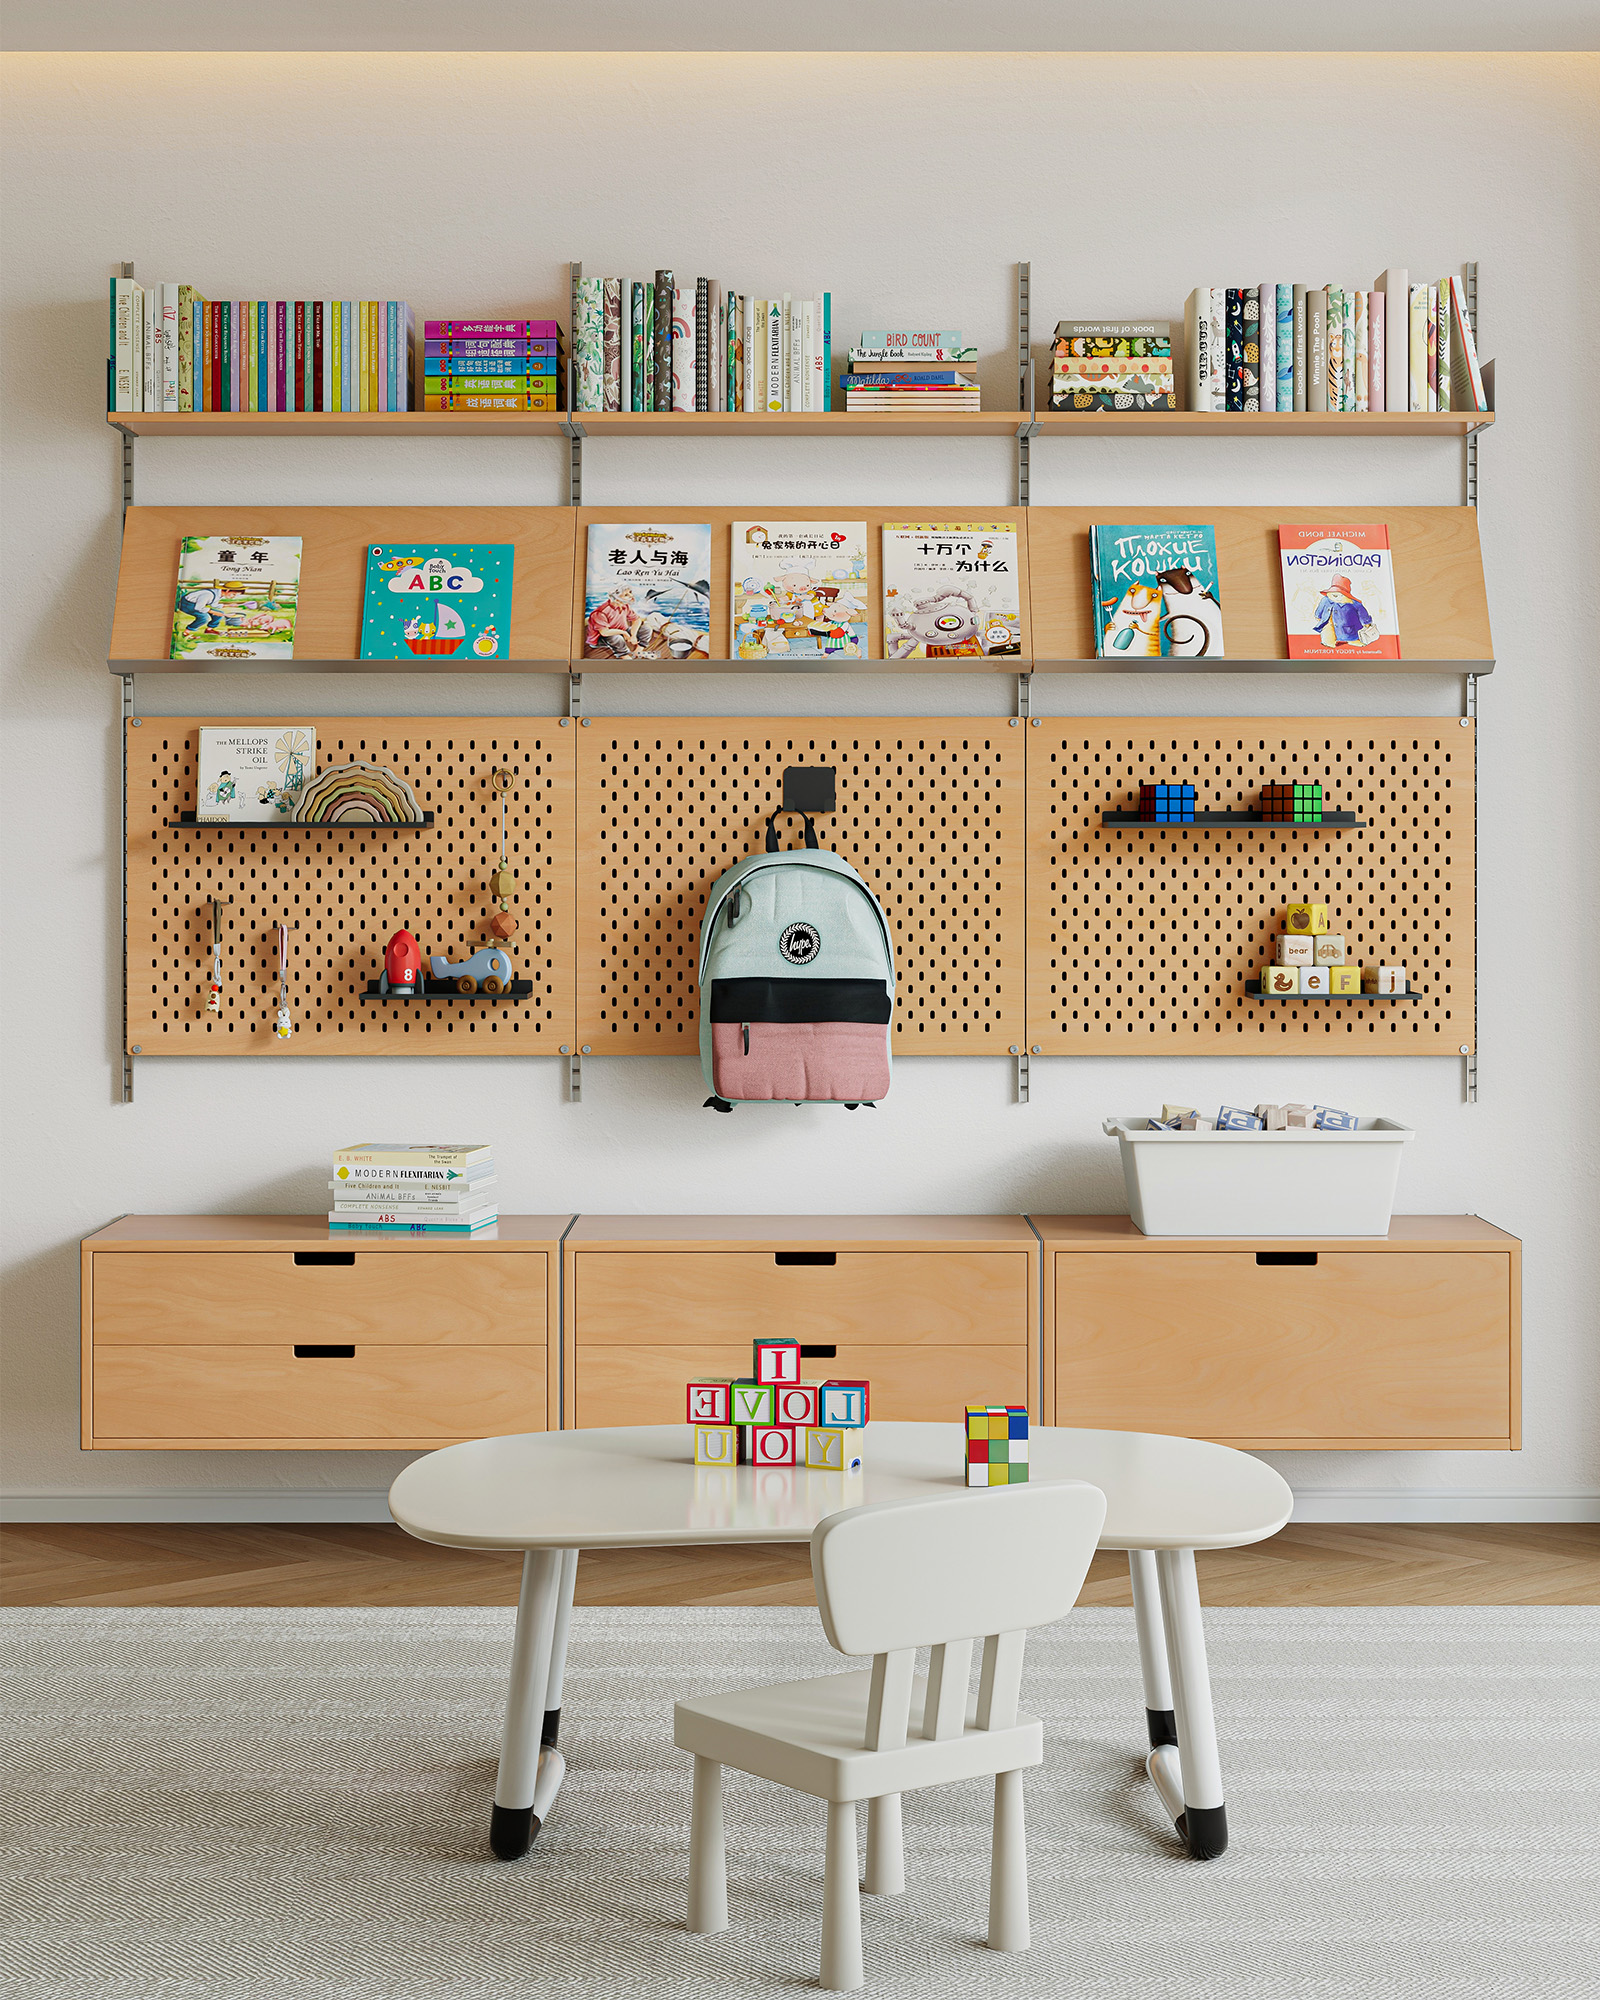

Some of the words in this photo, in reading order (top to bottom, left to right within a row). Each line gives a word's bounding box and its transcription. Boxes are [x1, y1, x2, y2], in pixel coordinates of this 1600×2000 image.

[118, 294, 130, 305] Five
[118, 306, 130, 329] Children
[118, 330, 130, 340] and
[1073, 326, 1101, 334] words
[1102, 326, 1119, 334] first
[1120, 326, 1131, 334] of
[1132, 326, 1155, 334] book
[771, 319, 779, 357] FLEXITARIAN
[911, 332, 941, 347] COUNT
[856, 349, 867, 358] The
[868, 348, 888, 362] Jungle
[889, 349, 904, 358] Book
[1198, 320, 1208, 381] CIRCUS
[815, 356, 823, 371] ABS
[1297, 356, 1304, 367] of
[771, 358, 779, 396] MODERN
[846, 374, 890, 385] Matilda
[118, 376, 129, 394] NESBIT
[466, 398, 518, 408] 成语词典
[916, 544, 972, 556] 十万个
[217, 550, 269, 563] 童年
[608, 548, 689, 566] 老人与海
[956, 560, 1009, 573] 为什么
[408, 574, 464, 591] ABC
[228, 738, 269, 746] MELLOPS
[252, 756, 268, 764] OIL
[1318, 912, 1325, 928] A
[1288, 946, 1308, 955] bear
[404, 968, 412, 981] 8
[1308, 975, 1321, 989] e
[1340, 974, 1352, 990] F
[1389, 970, 1396, 993] j
[355, 1168, 399, 1178] MODERN
[400, 1170, 444, 1179] FLEXITARIAN
[397, 1193, 416, 1201] BFFs
[378, 1214, 396, 1223] ABS
[348, 1222, 363, 1230] Baby
